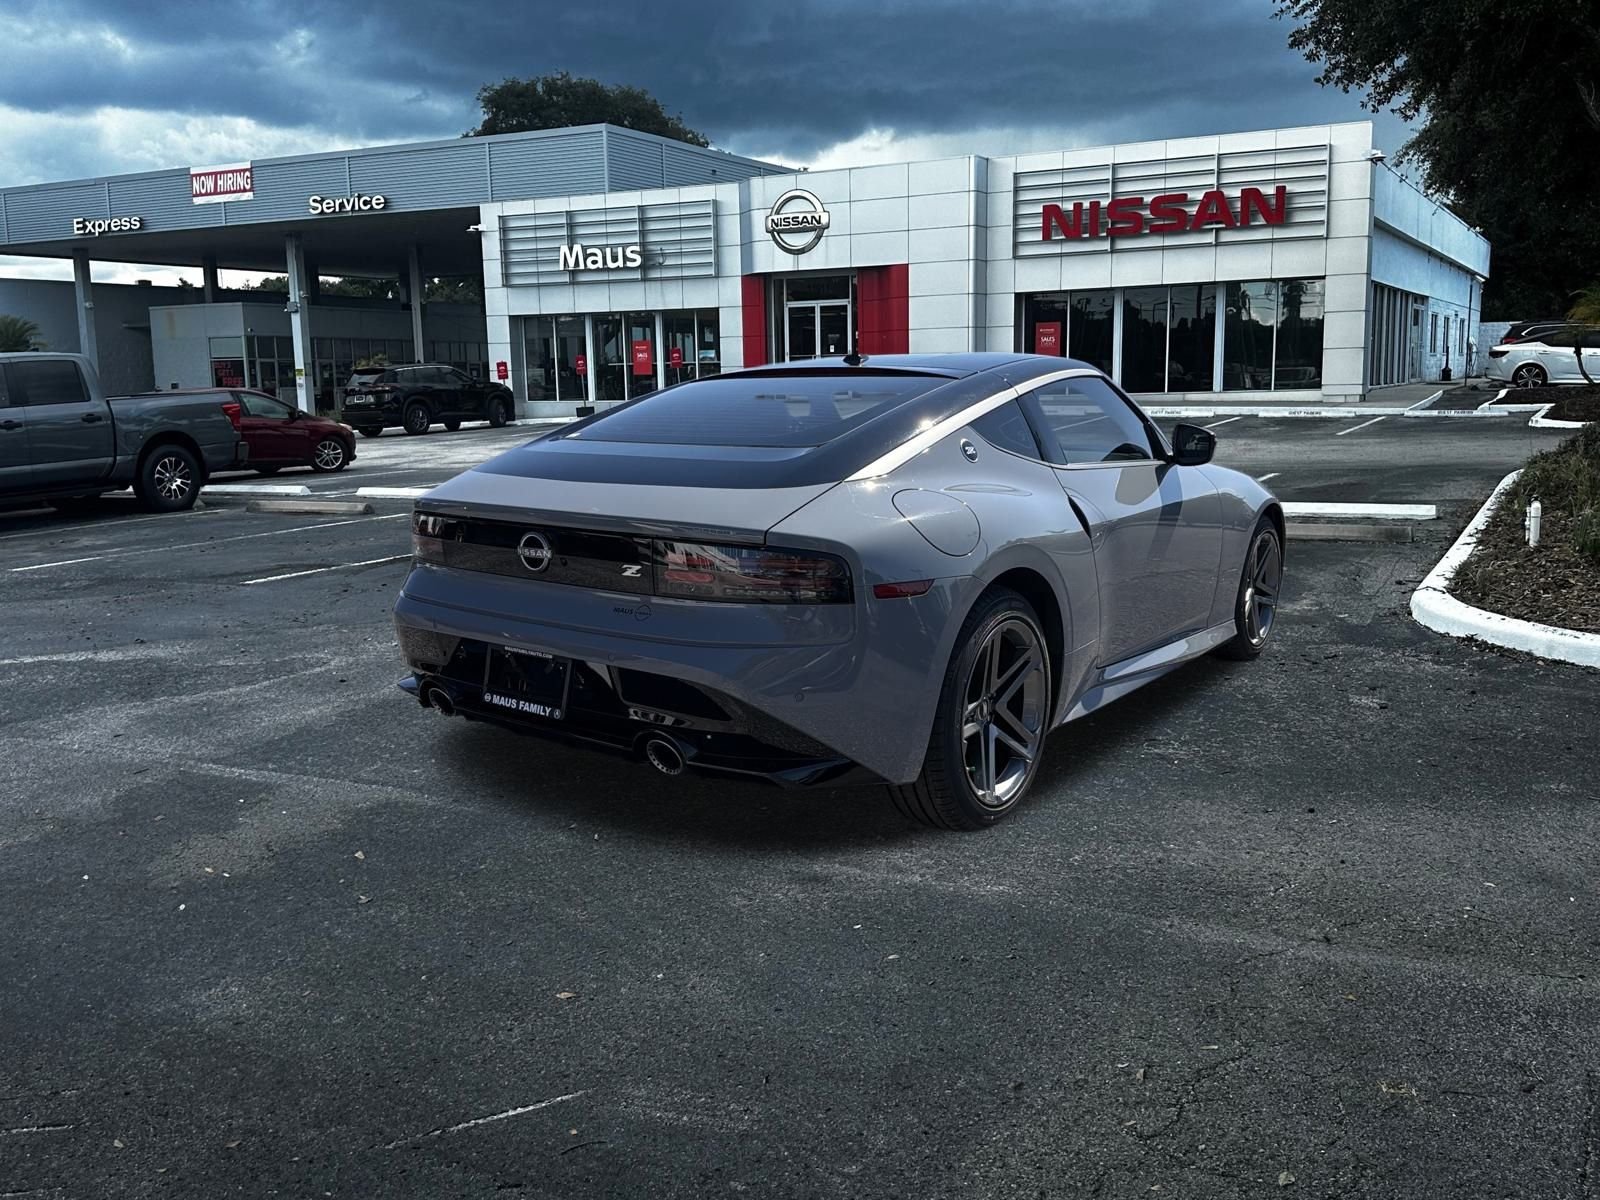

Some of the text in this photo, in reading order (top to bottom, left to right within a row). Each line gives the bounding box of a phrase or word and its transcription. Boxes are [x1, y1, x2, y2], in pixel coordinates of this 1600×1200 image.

[192, 170, 251, 194] NOW HIRING
[308, 193, 385, 214] Service
[1042, 185, 1287, 241] NISSAN
[73, 215, 141, 236] Express
[770, 214, 822, 229] NISSAN
[559, 244, 642, 271] Maus
[223, 377, 244, 386] FREE
[517, 545, 552, 559] NISSAN
[621, 564, 642, 577] Z
[613, 607, 633, 615] MAUS
[492, 694, 552, 717] MAUS FAMILY
